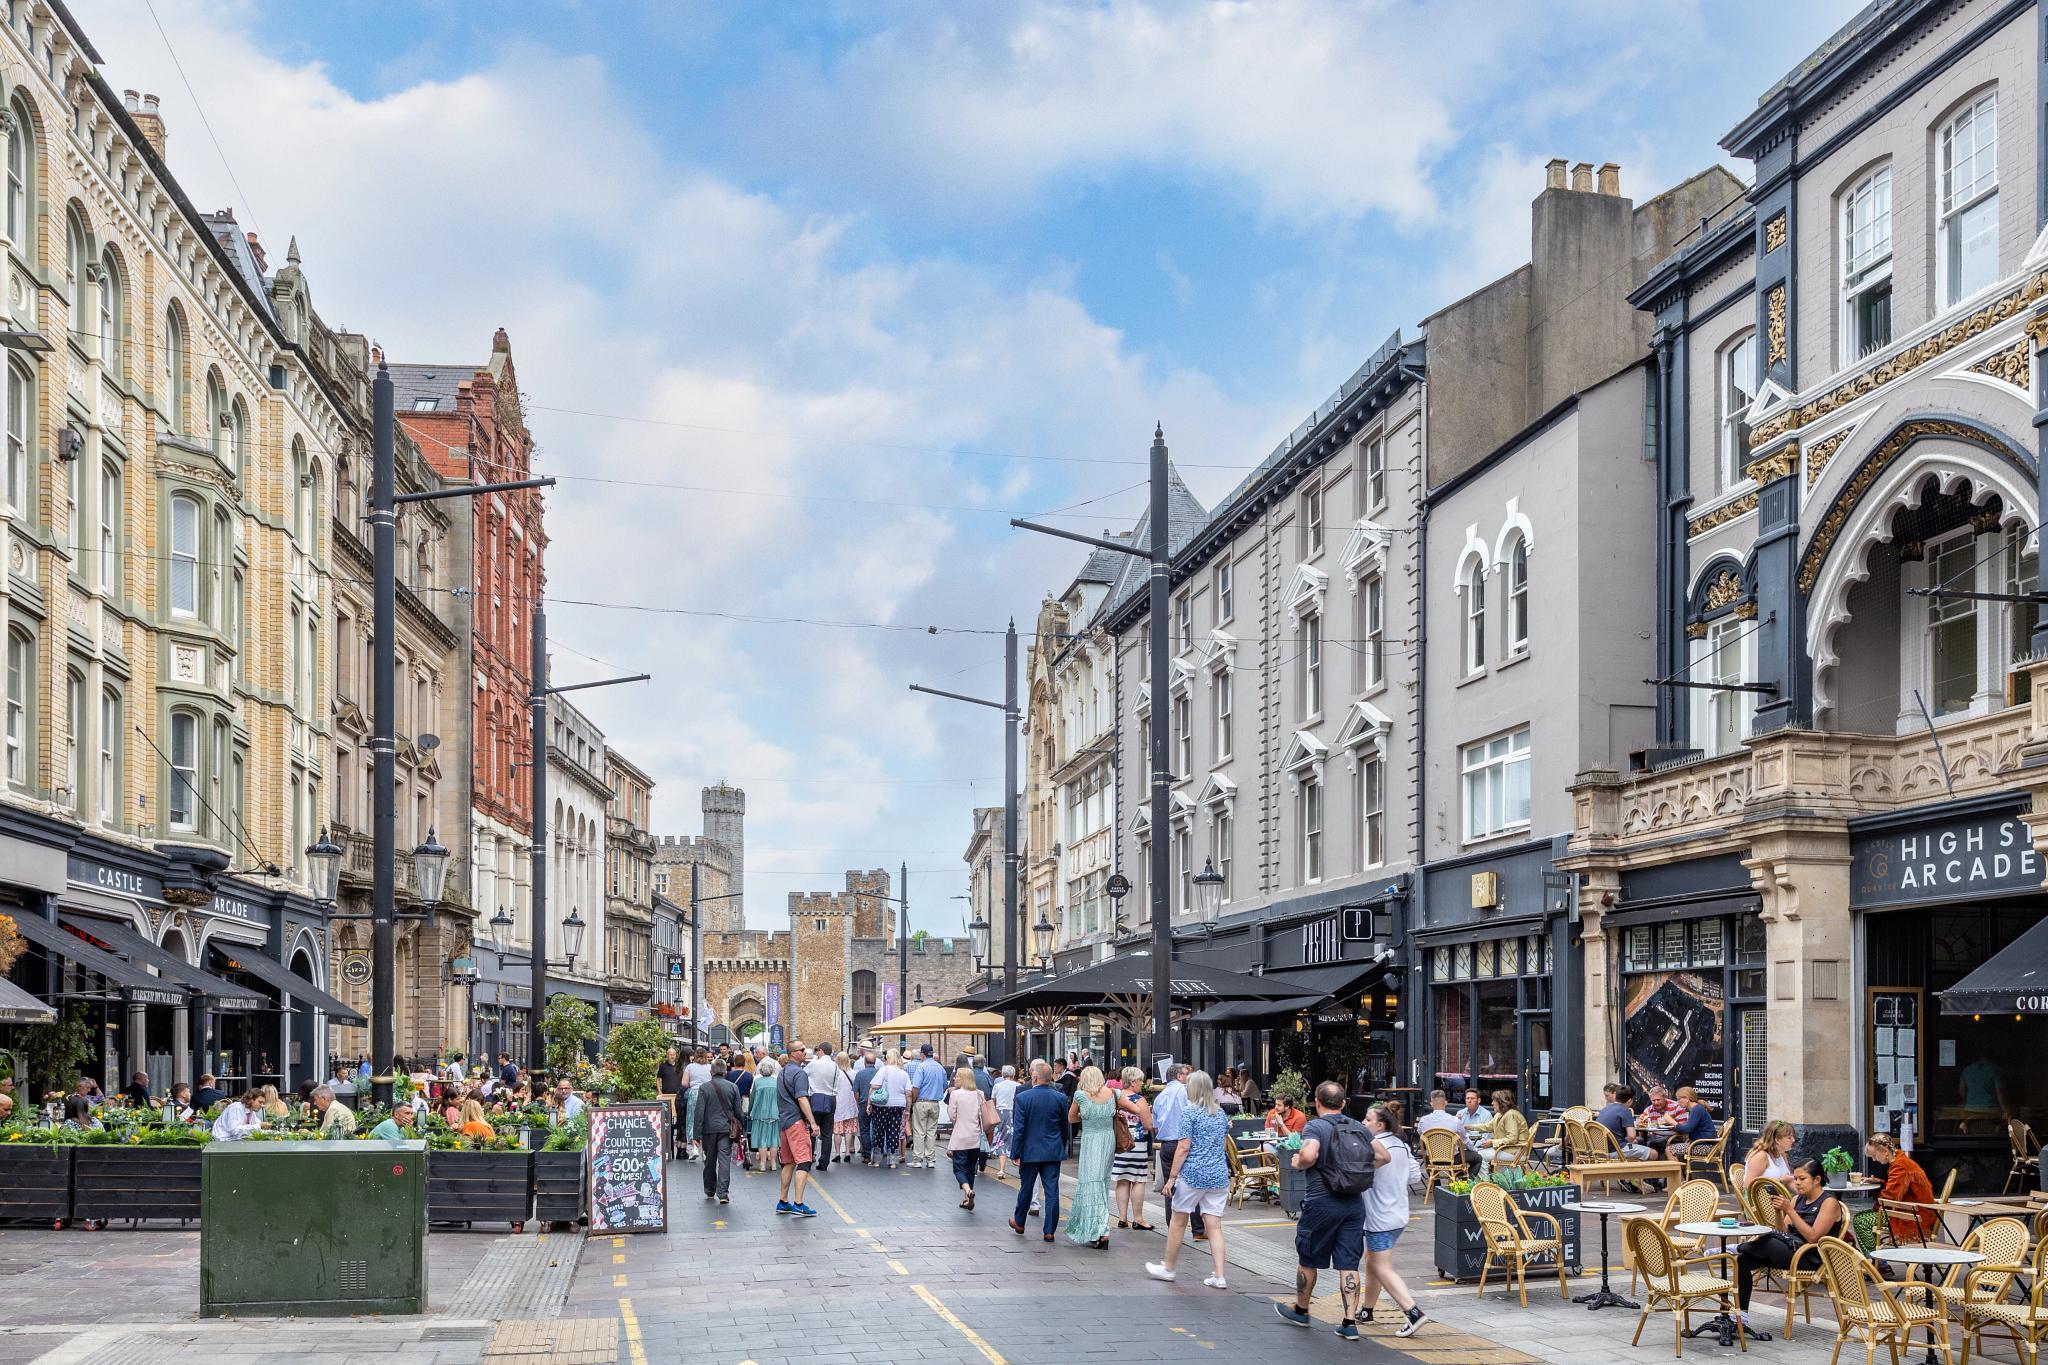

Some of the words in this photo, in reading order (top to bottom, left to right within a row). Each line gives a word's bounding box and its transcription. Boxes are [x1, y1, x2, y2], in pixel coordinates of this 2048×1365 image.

[1901, 826, 1983, 861] HIGH
[2000, 822, 2033, 847] ST
[1901, 850, 2036, 889] ARCADE
[98, 867, 143, 893] CASTLE
[214, 897, 248, 918] ARCADE
[344, 965, 367, 974] Zizzi
[1135, 981, 1215, 992] PTURE
[607, 1117, 647, 1130] CHANCE
[624, 1128, 631, 1137] &
[604, 1137, 654, 1148] COUNTERS
[612, 1157, 645, 1172] 500+
[613, 1172, 643, 1181] GAMES!
[1523, 1188, 1575, 1208] WINE
